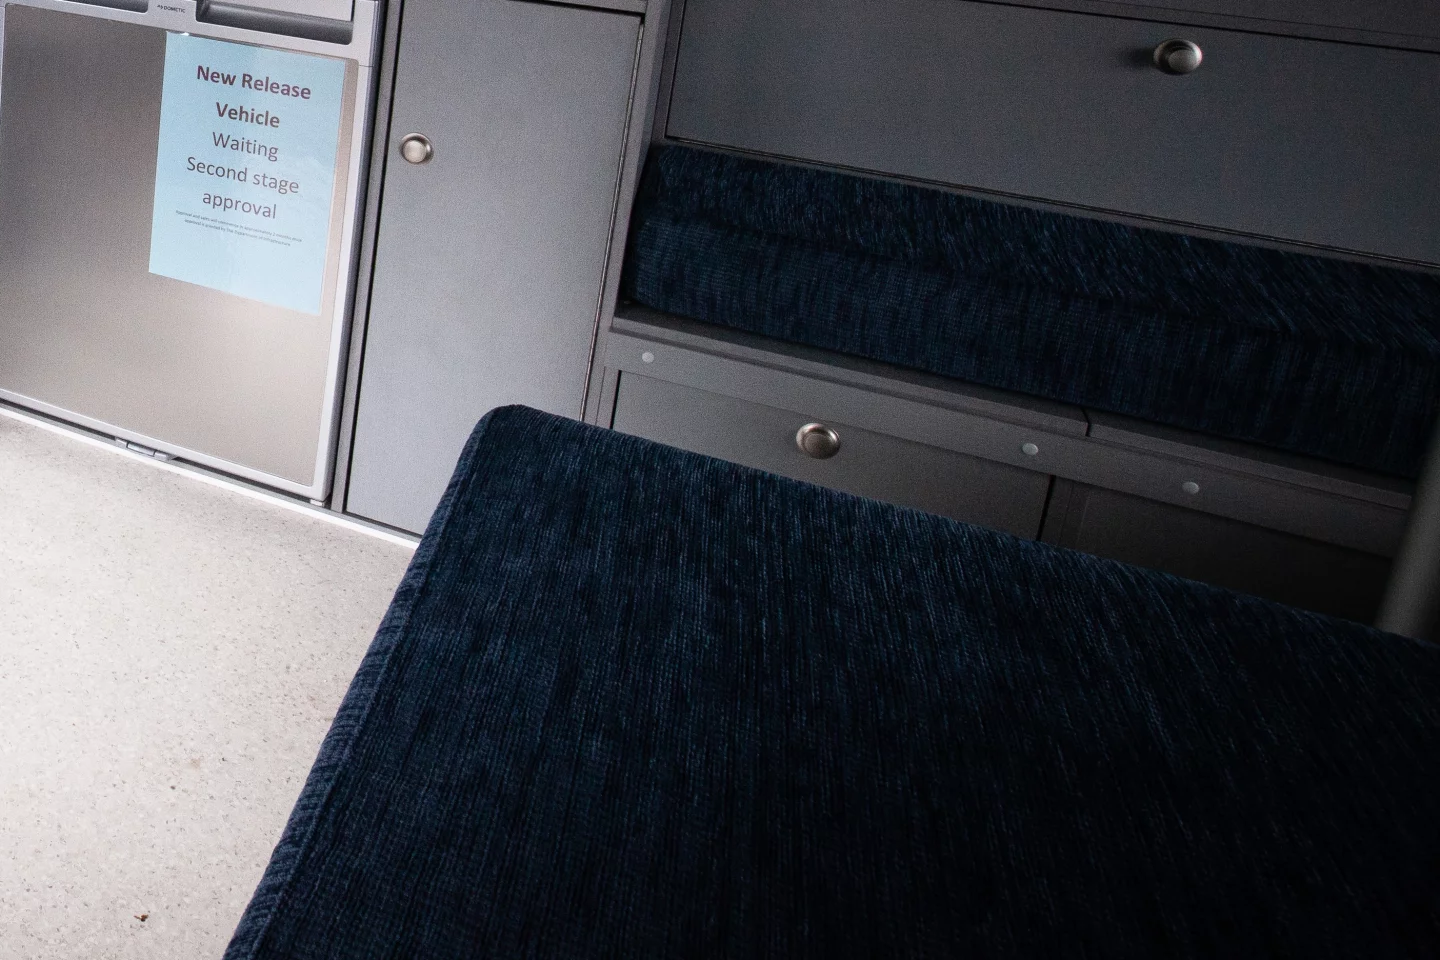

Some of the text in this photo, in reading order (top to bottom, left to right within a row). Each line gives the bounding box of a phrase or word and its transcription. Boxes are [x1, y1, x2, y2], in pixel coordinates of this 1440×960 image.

[197, 65, 311, 100] New Release
[216, 102, 280, 128] Vehicle
[212, 131, 278, 162] Waiting
[186, 156, 299, 195] Second stage
[202, 191, 277, 219] approval
